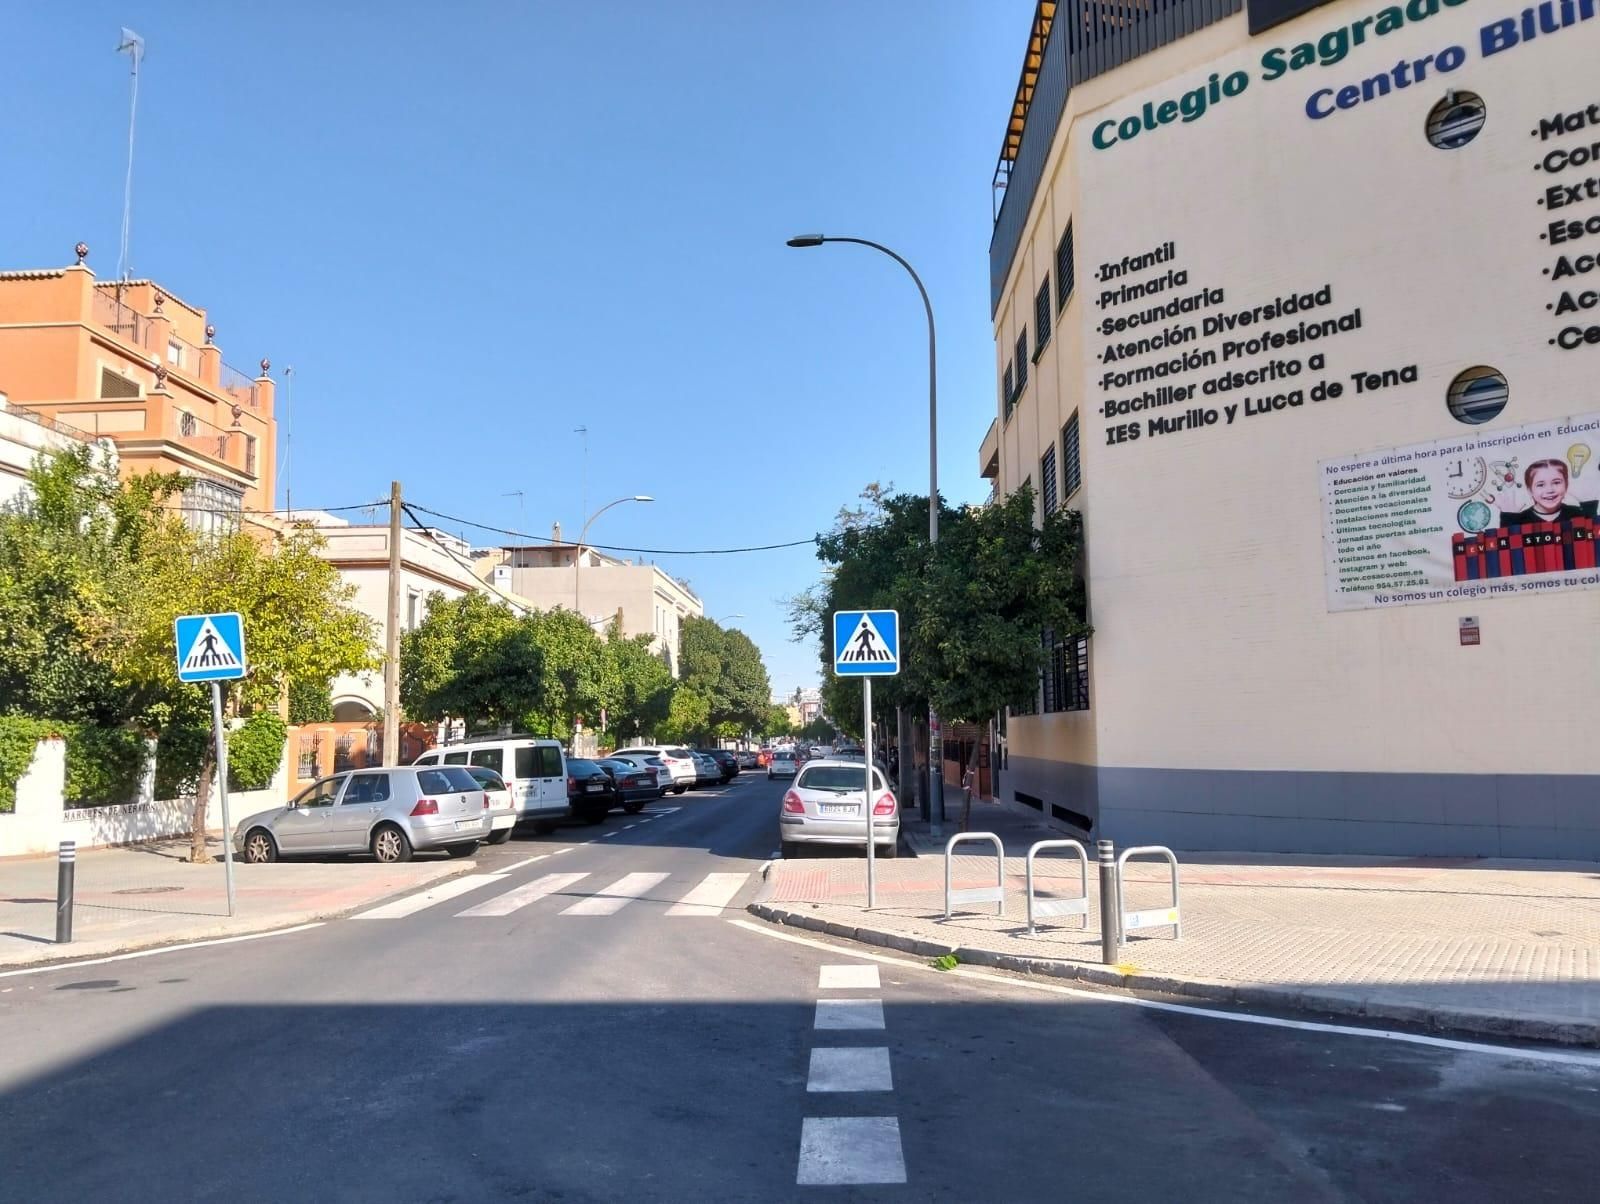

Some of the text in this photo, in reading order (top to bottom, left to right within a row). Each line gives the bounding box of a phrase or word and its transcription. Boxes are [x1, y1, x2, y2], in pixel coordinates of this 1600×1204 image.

[1092, 0, 1468, 150] Colegio Sagrad
[1305, 45, 1466, 120] Centro
[1100, 241, 1175, 282] Infantil
[1101, 270, 1187, 309] Primaria
[1102, 287, 1224, 335] Secundaria
[1103, 284, 1331, 364] Atención Diversidad
[1103, 308, 1361, 390] Formación Profesional
[1105, 353, 1325, 418] Bachiller adscrito a
[1106, 365, 1418, 445] IES Murillo y Luca de Tena
[1326, 466, 1339, 474] No
[1340, 461, 1371, 472] espere
[1381, 453, 1412, 465] última
[1414, 450, 1437, 460] hora
[1440, 445, 1463, 456] para
[1465, 442, 1475, 451] la
[1477, 432, 1535, 448] inscripción
[1537, 430, 1552, 438] en
[1388, 467, 1418, 477] valores
[1377, 475, 1426, 489] familiaridad
[1378, 491, 1387, 499] la
[1388, 485, 1431, 497] diversidad
[1335, 497, 1428, 514] Docentes vocacionales
[1336, 506, 1432, 524] Instalaciones modernas
[1337, 525, 1443, 544] Jornadas puertas abiertas
[1338, 546, 1355, 554] todo
[1374, 595, 1389, 604] No
[1392, 592, 1426, 602] somos
[1429, 590, 1443, 599] un
[1446, 585, 1487, 598] colegio
[1490, 581, 1518, 593] más,
[1521, 578, 1560, 590] somos
[1564, 576, 1577, 587] tu
